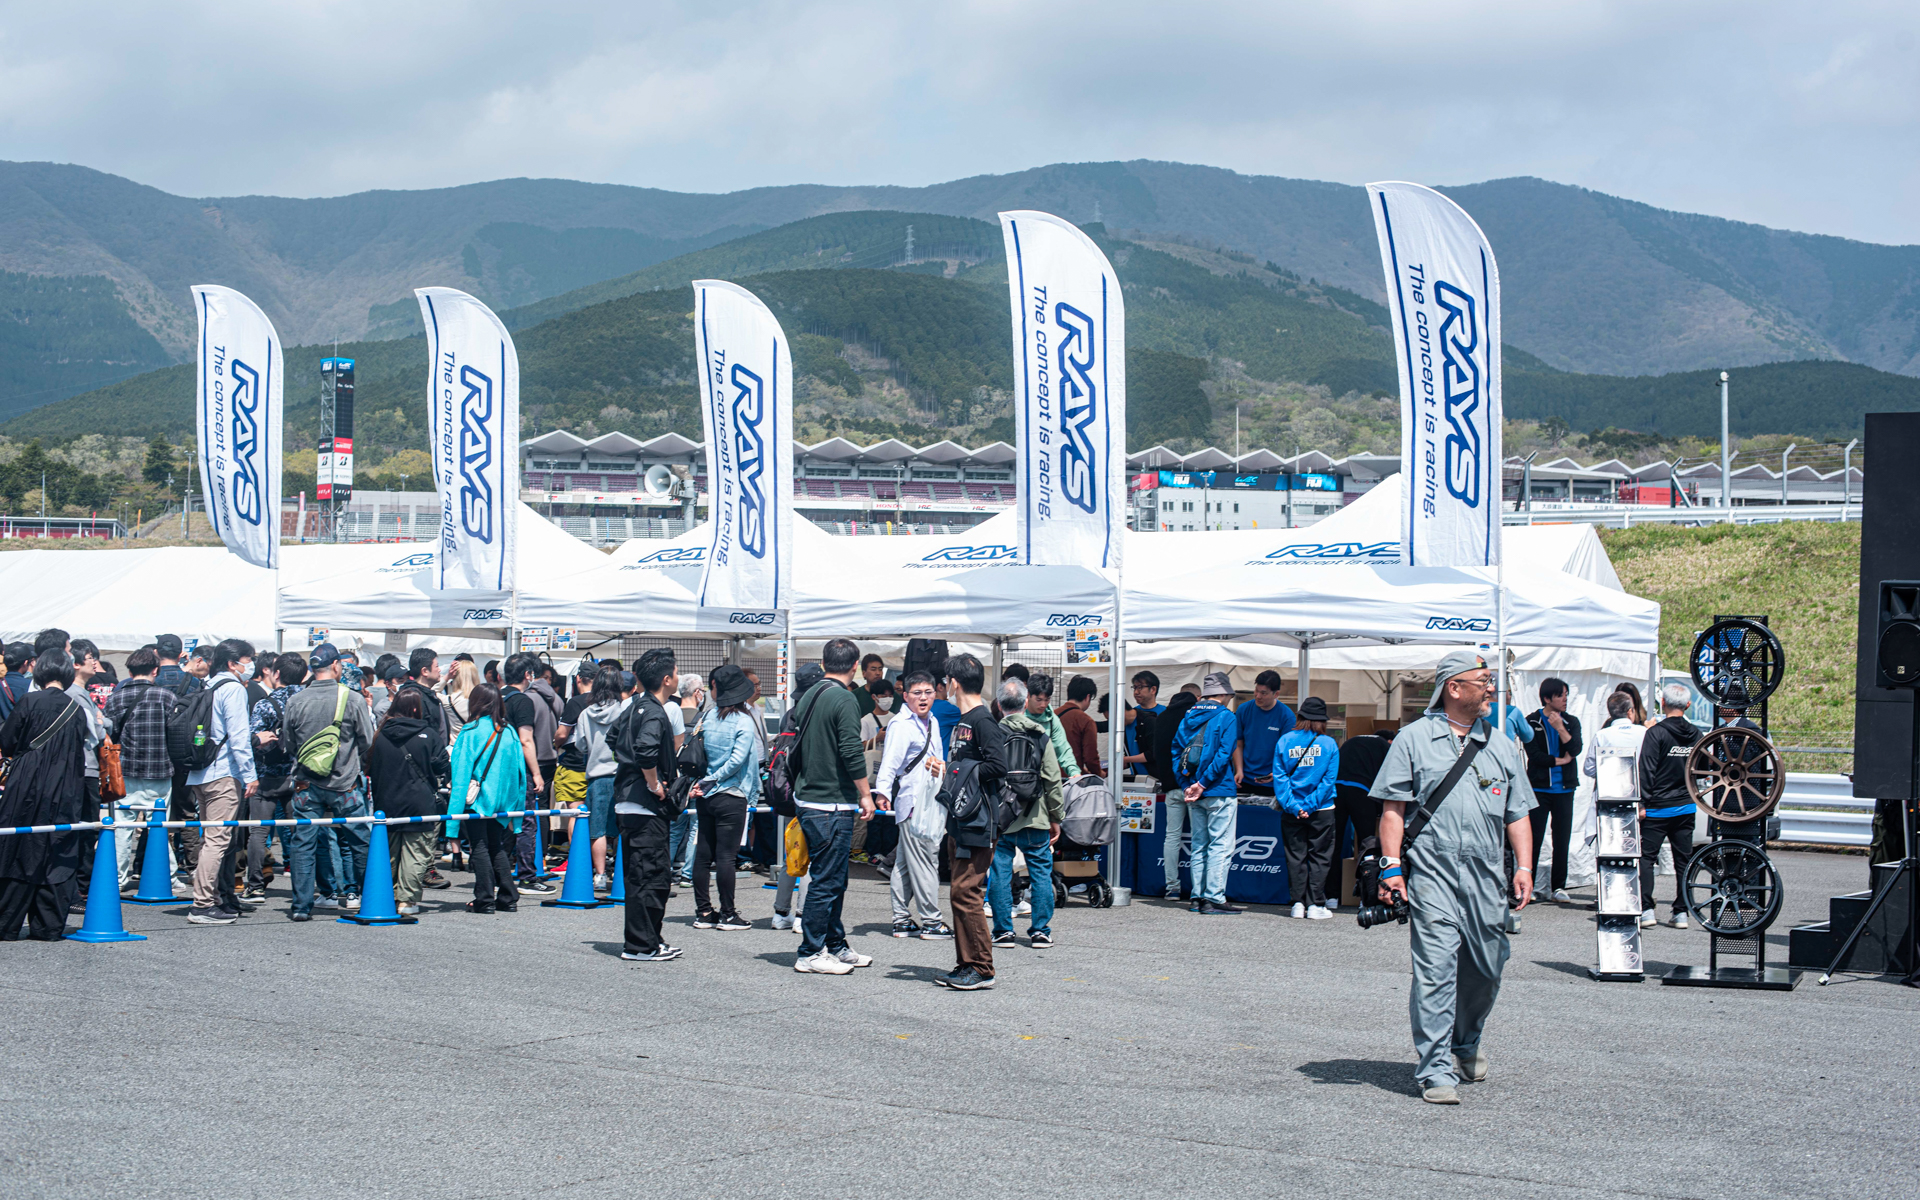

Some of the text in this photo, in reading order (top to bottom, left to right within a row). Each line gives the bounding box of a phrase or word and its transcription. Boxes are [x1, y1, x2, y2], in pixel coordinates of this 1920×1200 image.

[214, 345, 226, 376] The
[1408, 263, 1438, 519] The concept is racing.
[1434, 280, 1480, 508] RAYS
[214, 377, 226, 453] concept
[1033, 285, 1052, 521] The concept is racing.
[1055, 302, 1096, 514] RAYS
[215, 457, 226, 472] is
[231, 358, 261, 526] RAYS
[443, 351, 457, 553] The concept is racing.
[460, 365, 493, 544] RAYS
[713, 349, 734, 567] The concept is racing.
[731, 363, 766, 559] RAYS
[1173, 476, 1190, 485] FUJI
[921, 545, 1018, 561] RAY
[463, 609, 503, 619] RAYS
[730, 612, 776, 624] RAYS
[1046, 614, 1102, 626] RAYS
[1426, 616, 1491, 631] RAYS
[1241, 863, 1281, 874] racing.
